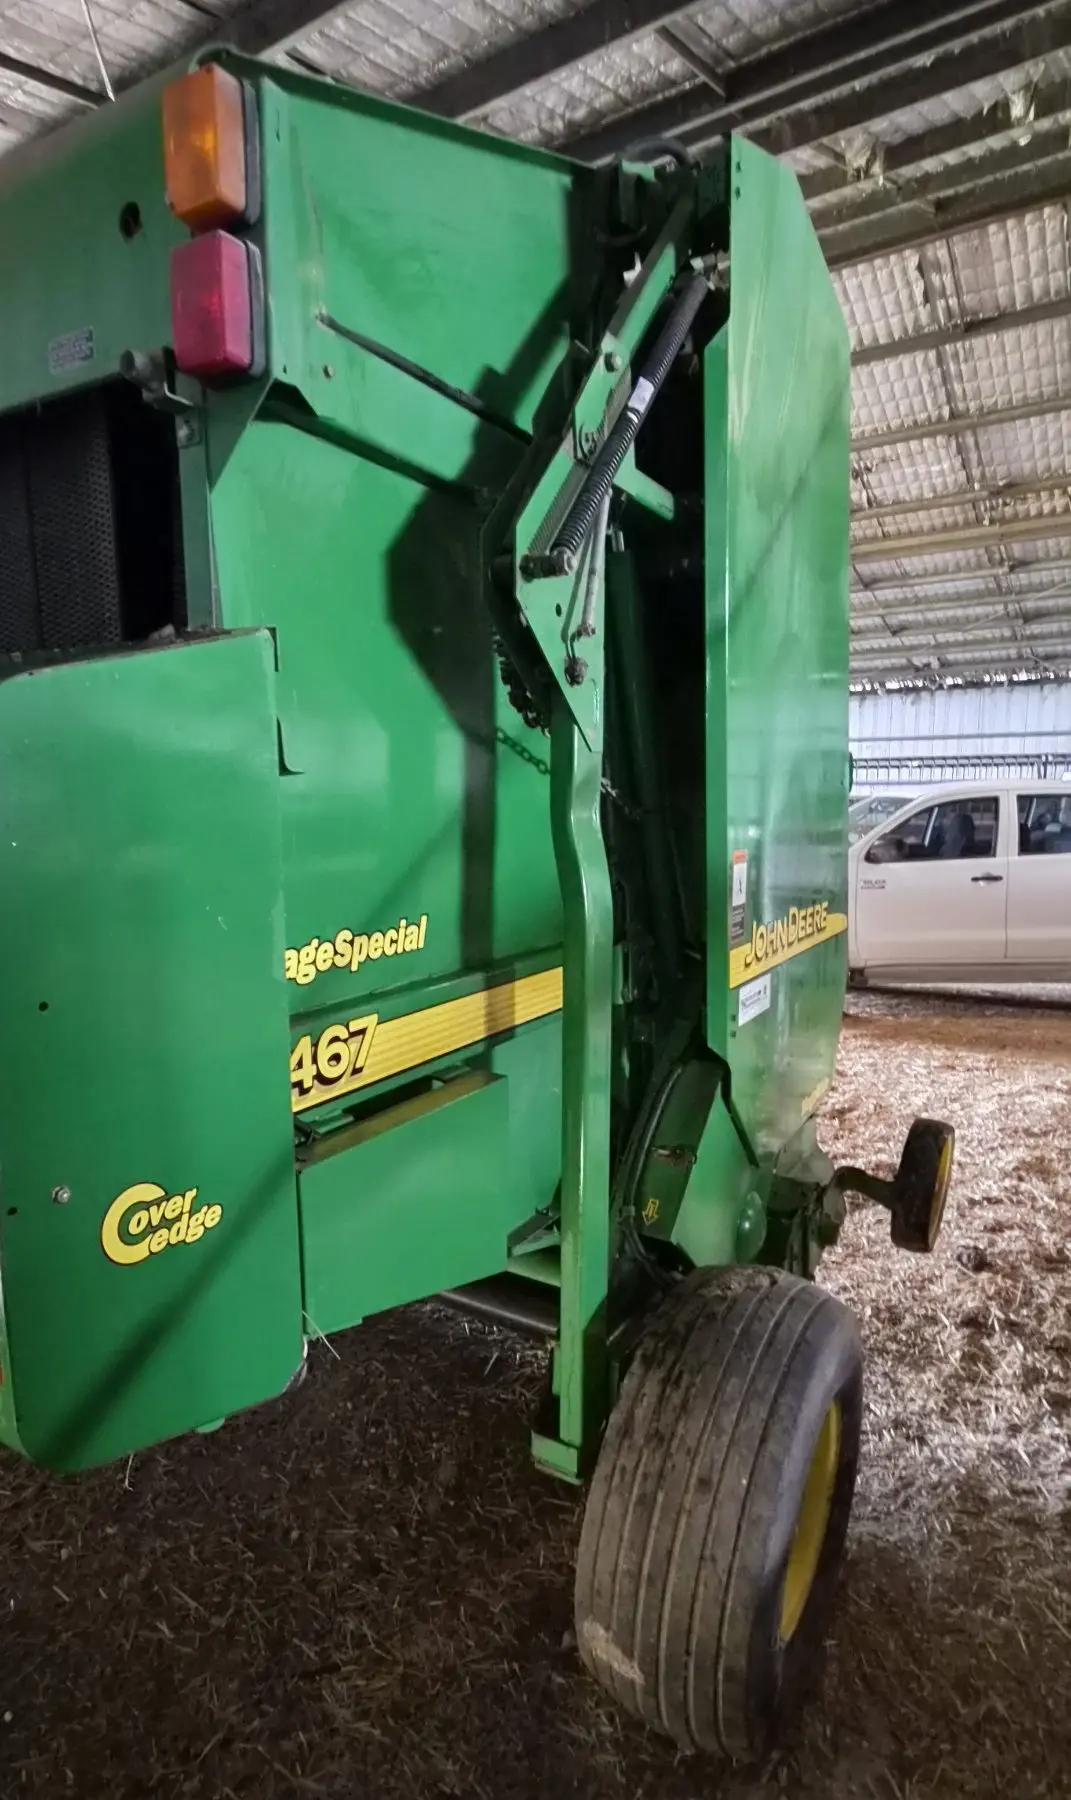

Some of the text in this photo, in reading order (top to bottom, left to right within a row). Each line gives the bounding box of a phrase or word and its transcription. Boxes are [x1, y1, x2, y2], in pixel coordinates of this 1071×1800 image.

[744, 917, 789, 969] JOHN
[787, 901, 829, 947] DEERE
[290, 1013, 379, 1092] 467
[101, 1182, 198, 1266] Cover
[149, 1203, 223, 1254] edge
